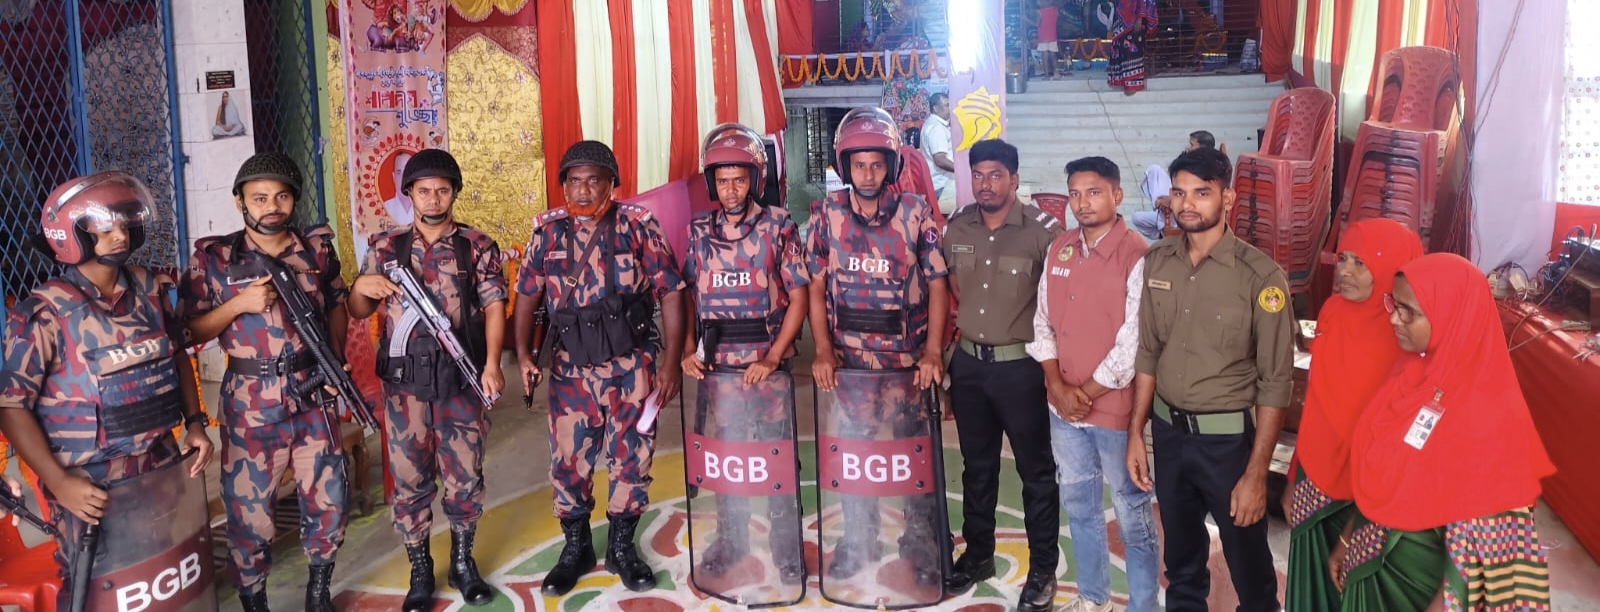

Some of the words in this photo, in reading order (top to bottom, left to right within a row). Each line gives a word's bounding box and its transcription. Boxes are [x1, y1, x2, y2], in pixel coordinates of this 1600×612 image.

[43, 227, 67, 241] BGB
[847, 256, 890, 273] BGB
[711, 272, 751, 288] BGB
[106, 338, 160, 366] BGB
[704, 451, 769, 483] BGB
[842, 452, 912, 483] BGB
[116, 552, 201, 612] BGB
